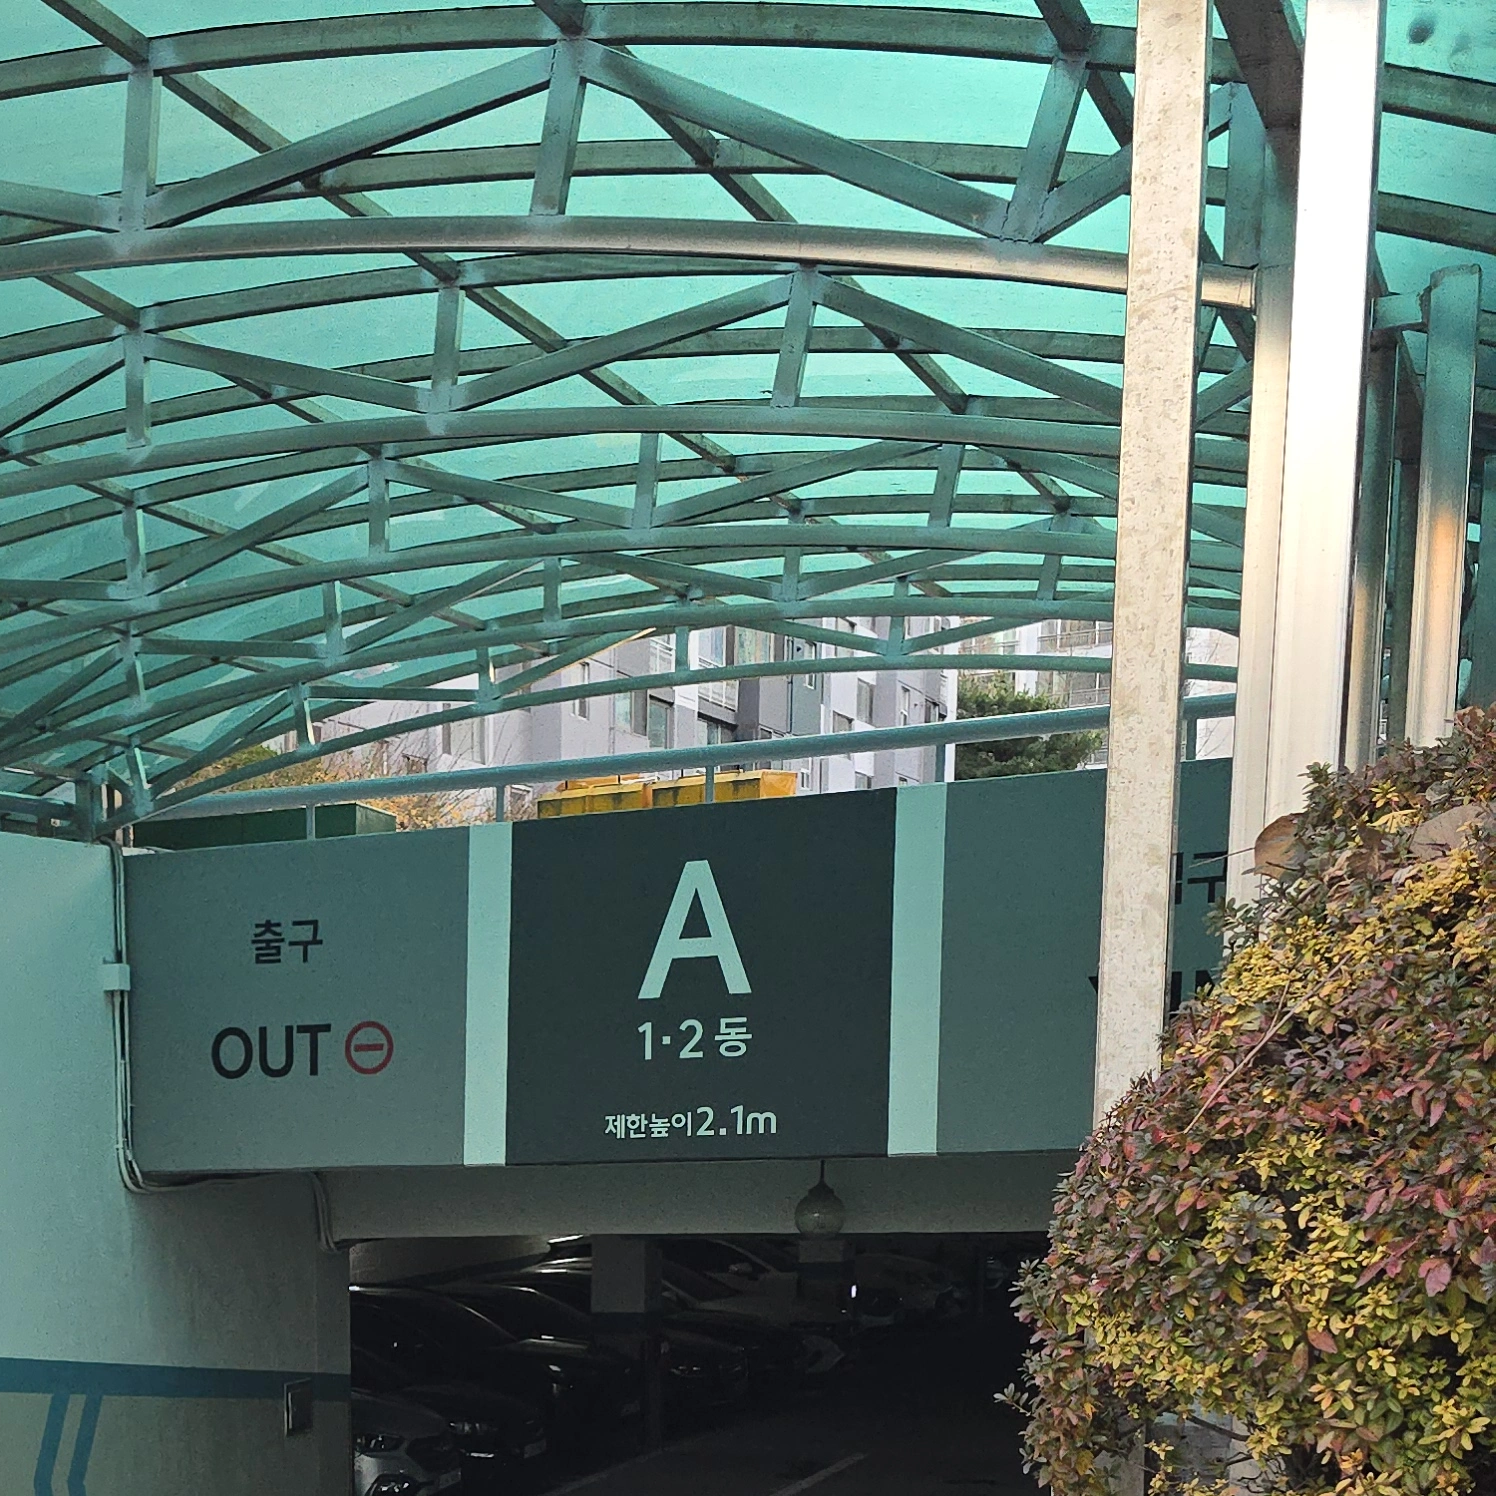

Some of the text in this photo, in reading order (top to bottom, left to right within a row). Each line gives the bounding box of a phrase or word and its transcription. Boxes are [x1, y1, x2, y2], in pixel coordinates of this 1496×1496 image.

[251, 919, 323, 964] 출구
[638, 859, 752, 999] A
[211, 1023, 332, 1079] OUT
